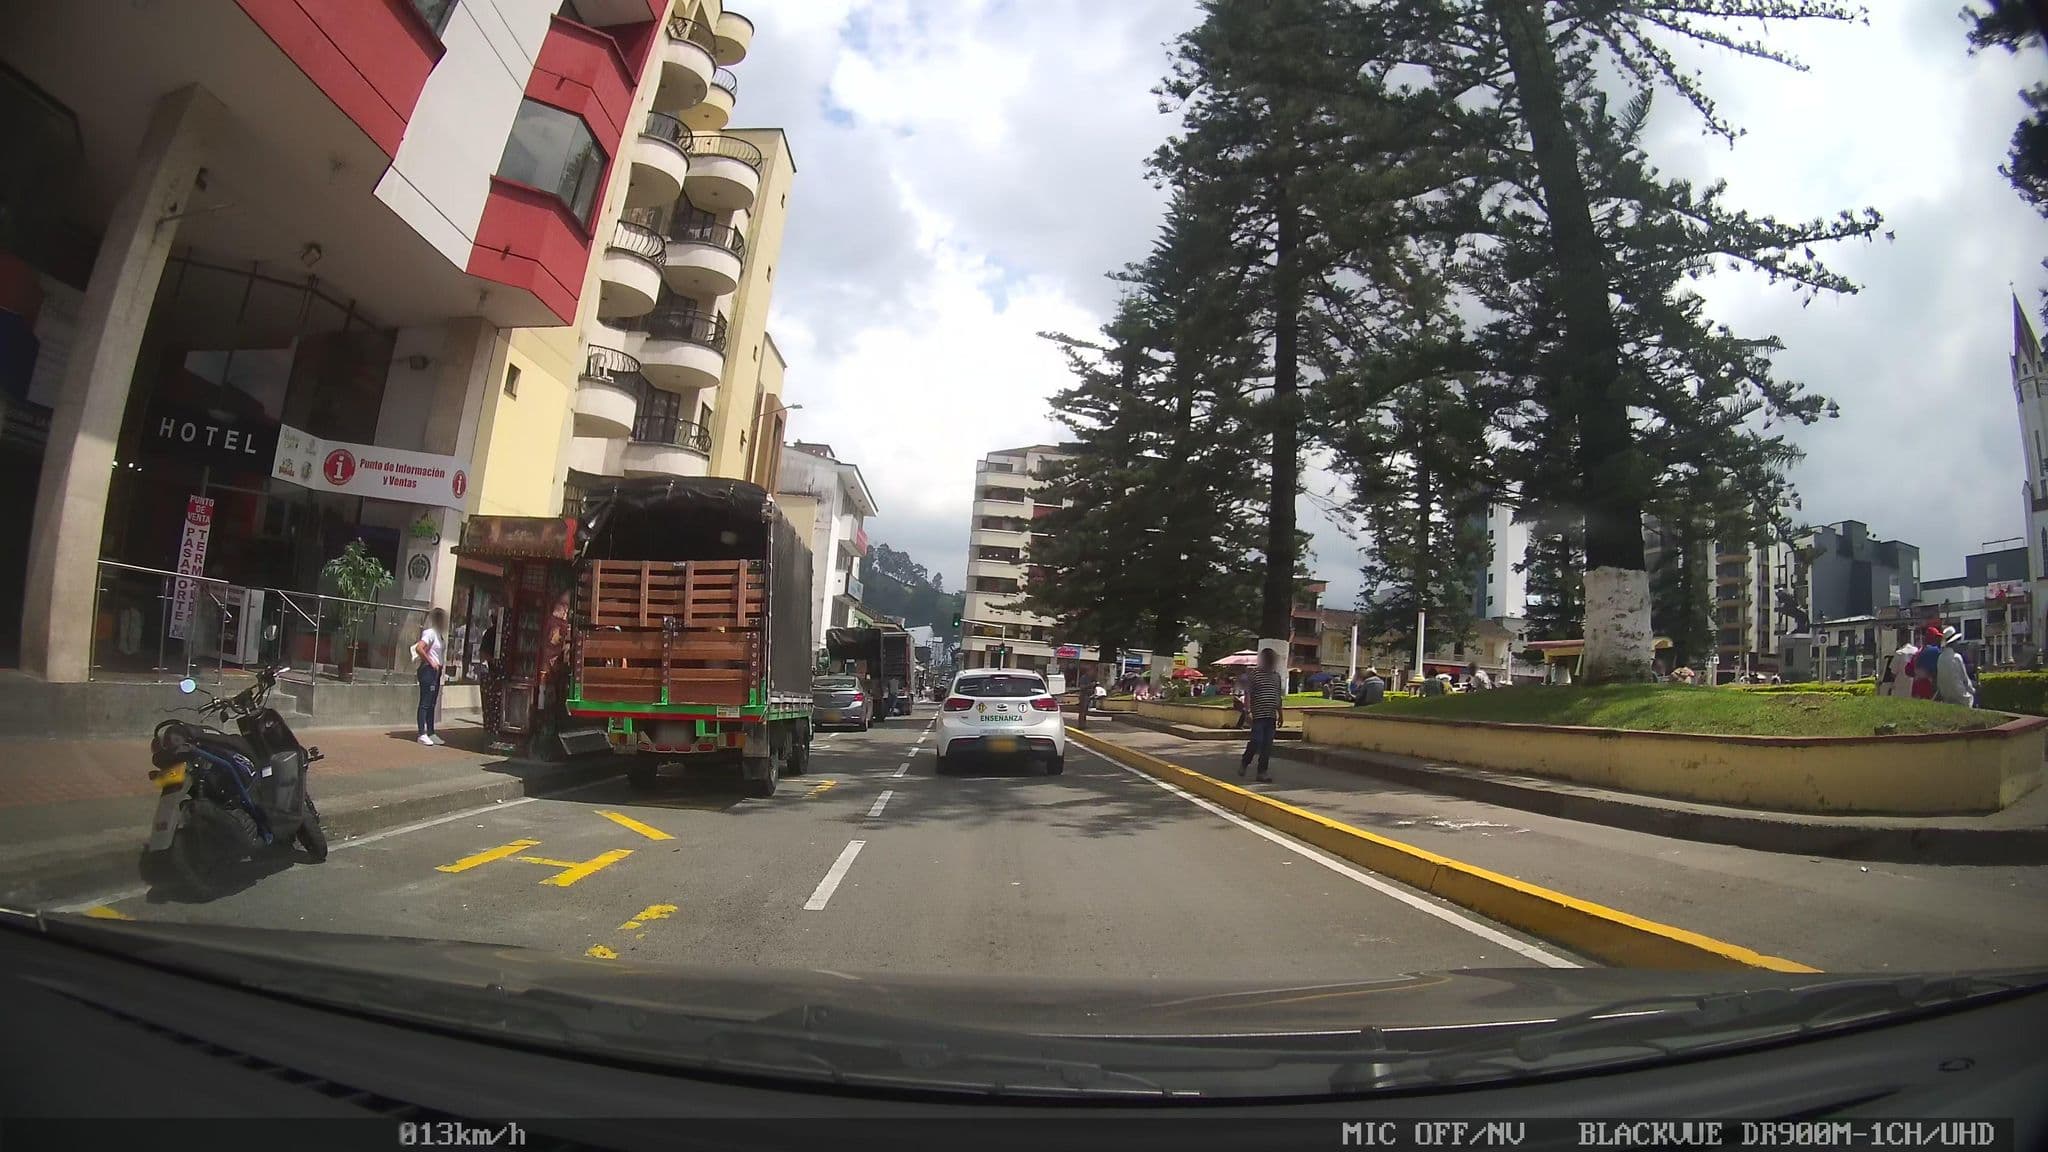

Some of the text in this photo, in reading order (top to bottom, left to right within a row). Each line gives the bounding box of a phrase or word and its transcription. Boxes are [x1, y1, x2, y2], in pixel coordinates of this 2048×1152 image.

[159, 417, 256, 454] HOTEL
[359, 458, 446, 478] Punto de Información
[383, 475, 417, 488] y Ventas
[190, 494, 214, 507] PUNTO
[195, 505, 205, 514] DE
[187, 511, 210, 523] VENTA
